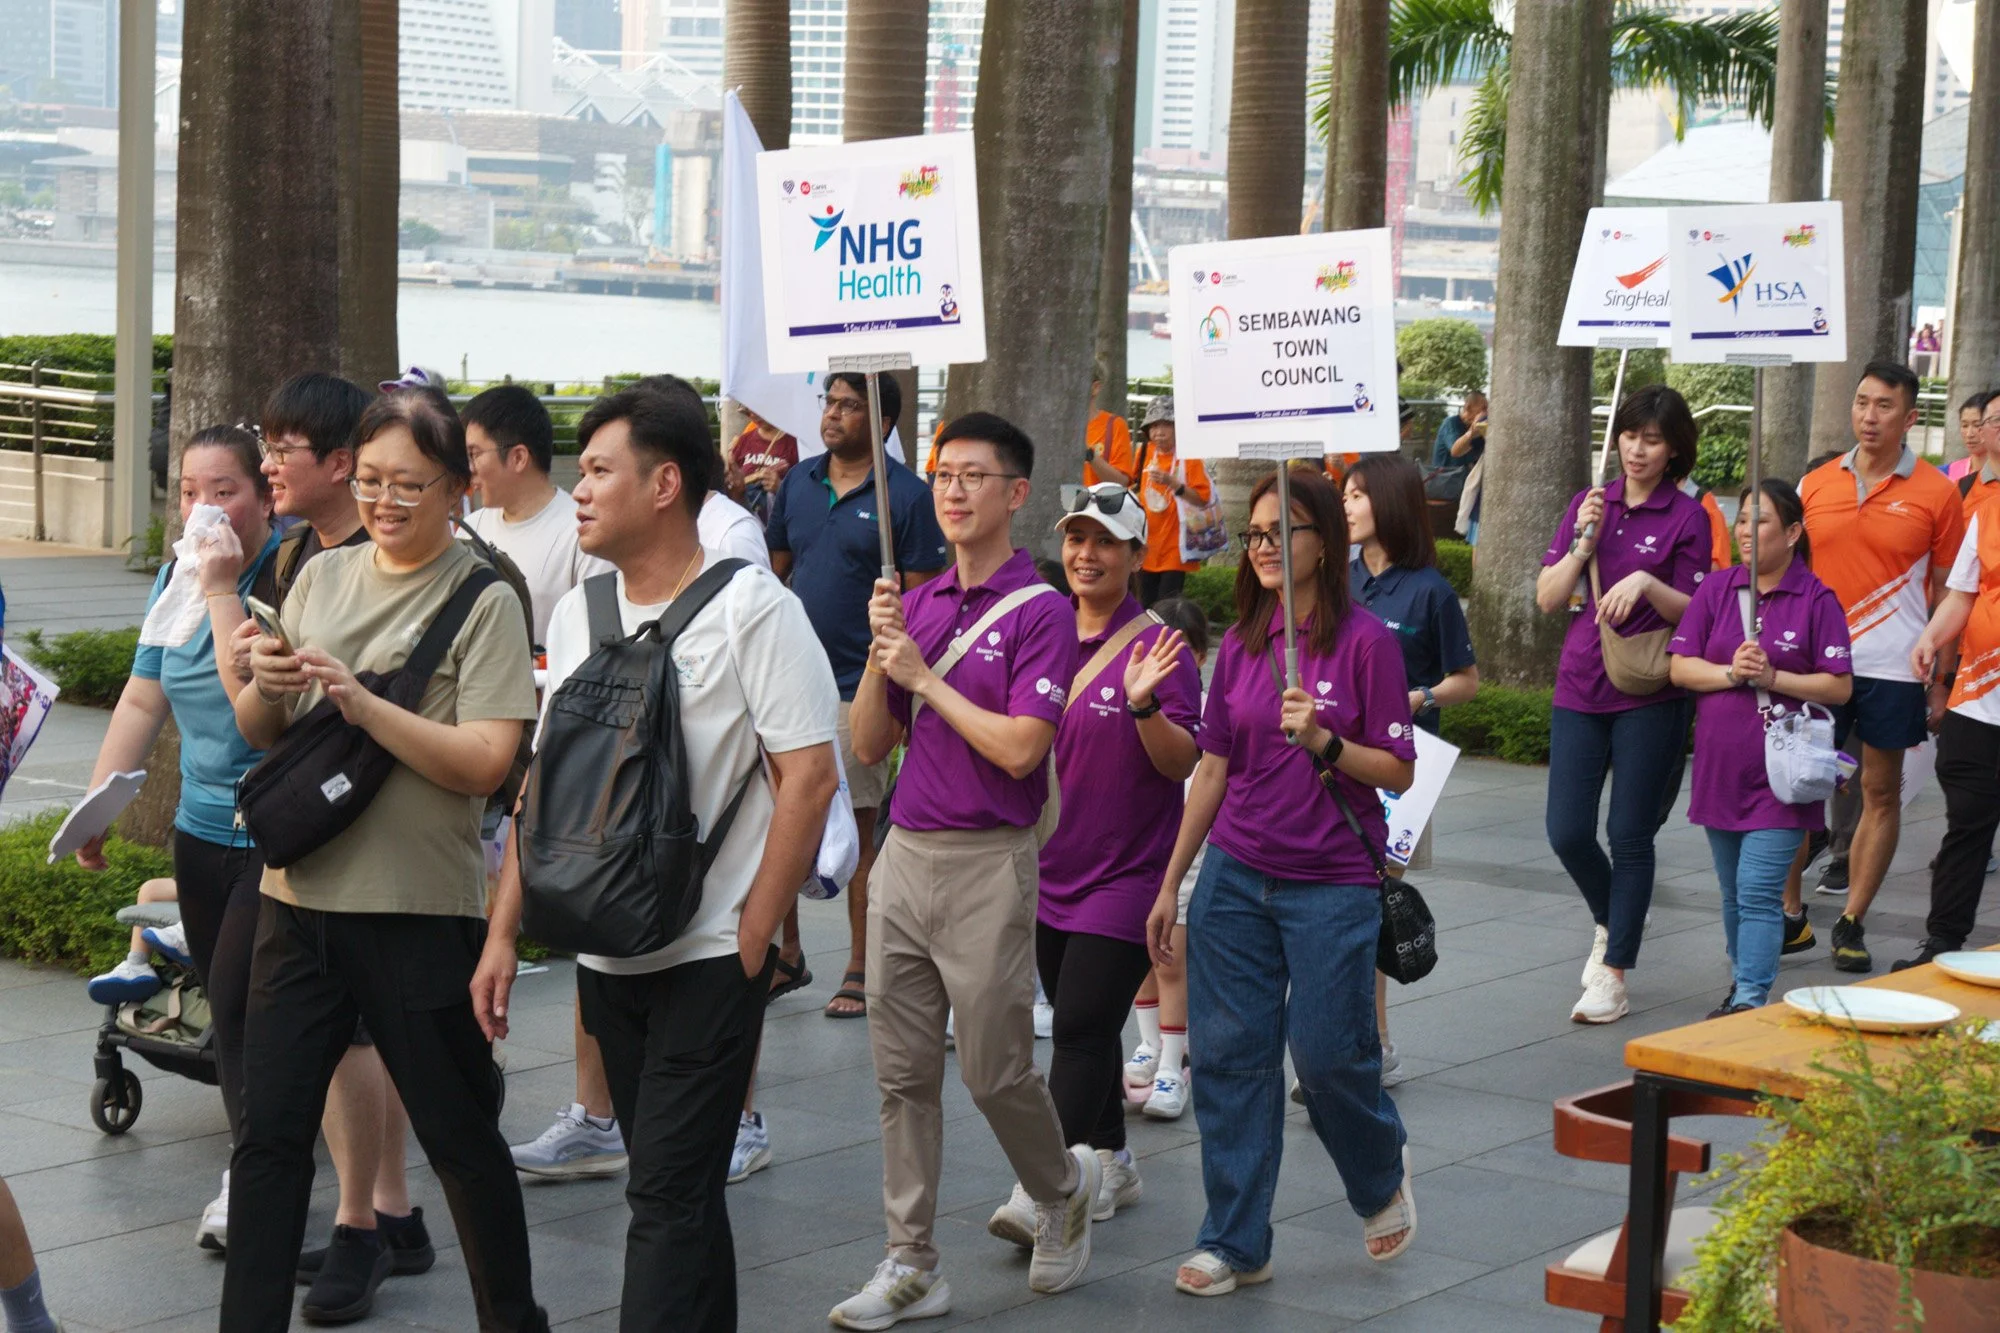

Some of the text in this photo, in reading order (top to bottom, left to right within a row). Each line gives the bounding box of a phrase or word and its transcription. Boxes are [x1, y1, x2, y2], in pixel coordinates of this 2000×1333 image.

[840, 218, 922, 266] NHG
[838, 263, 921, 301] Health
[1755, 282, 1807, 301] HSA
[1603, 289, 1671, 311] SingHeal
[1238, 305, 1362, 332] SEMBAWANG
[1273, 338, 1328, 359] TOWN
[1261, 365, 1344, 387] COUNCIL
